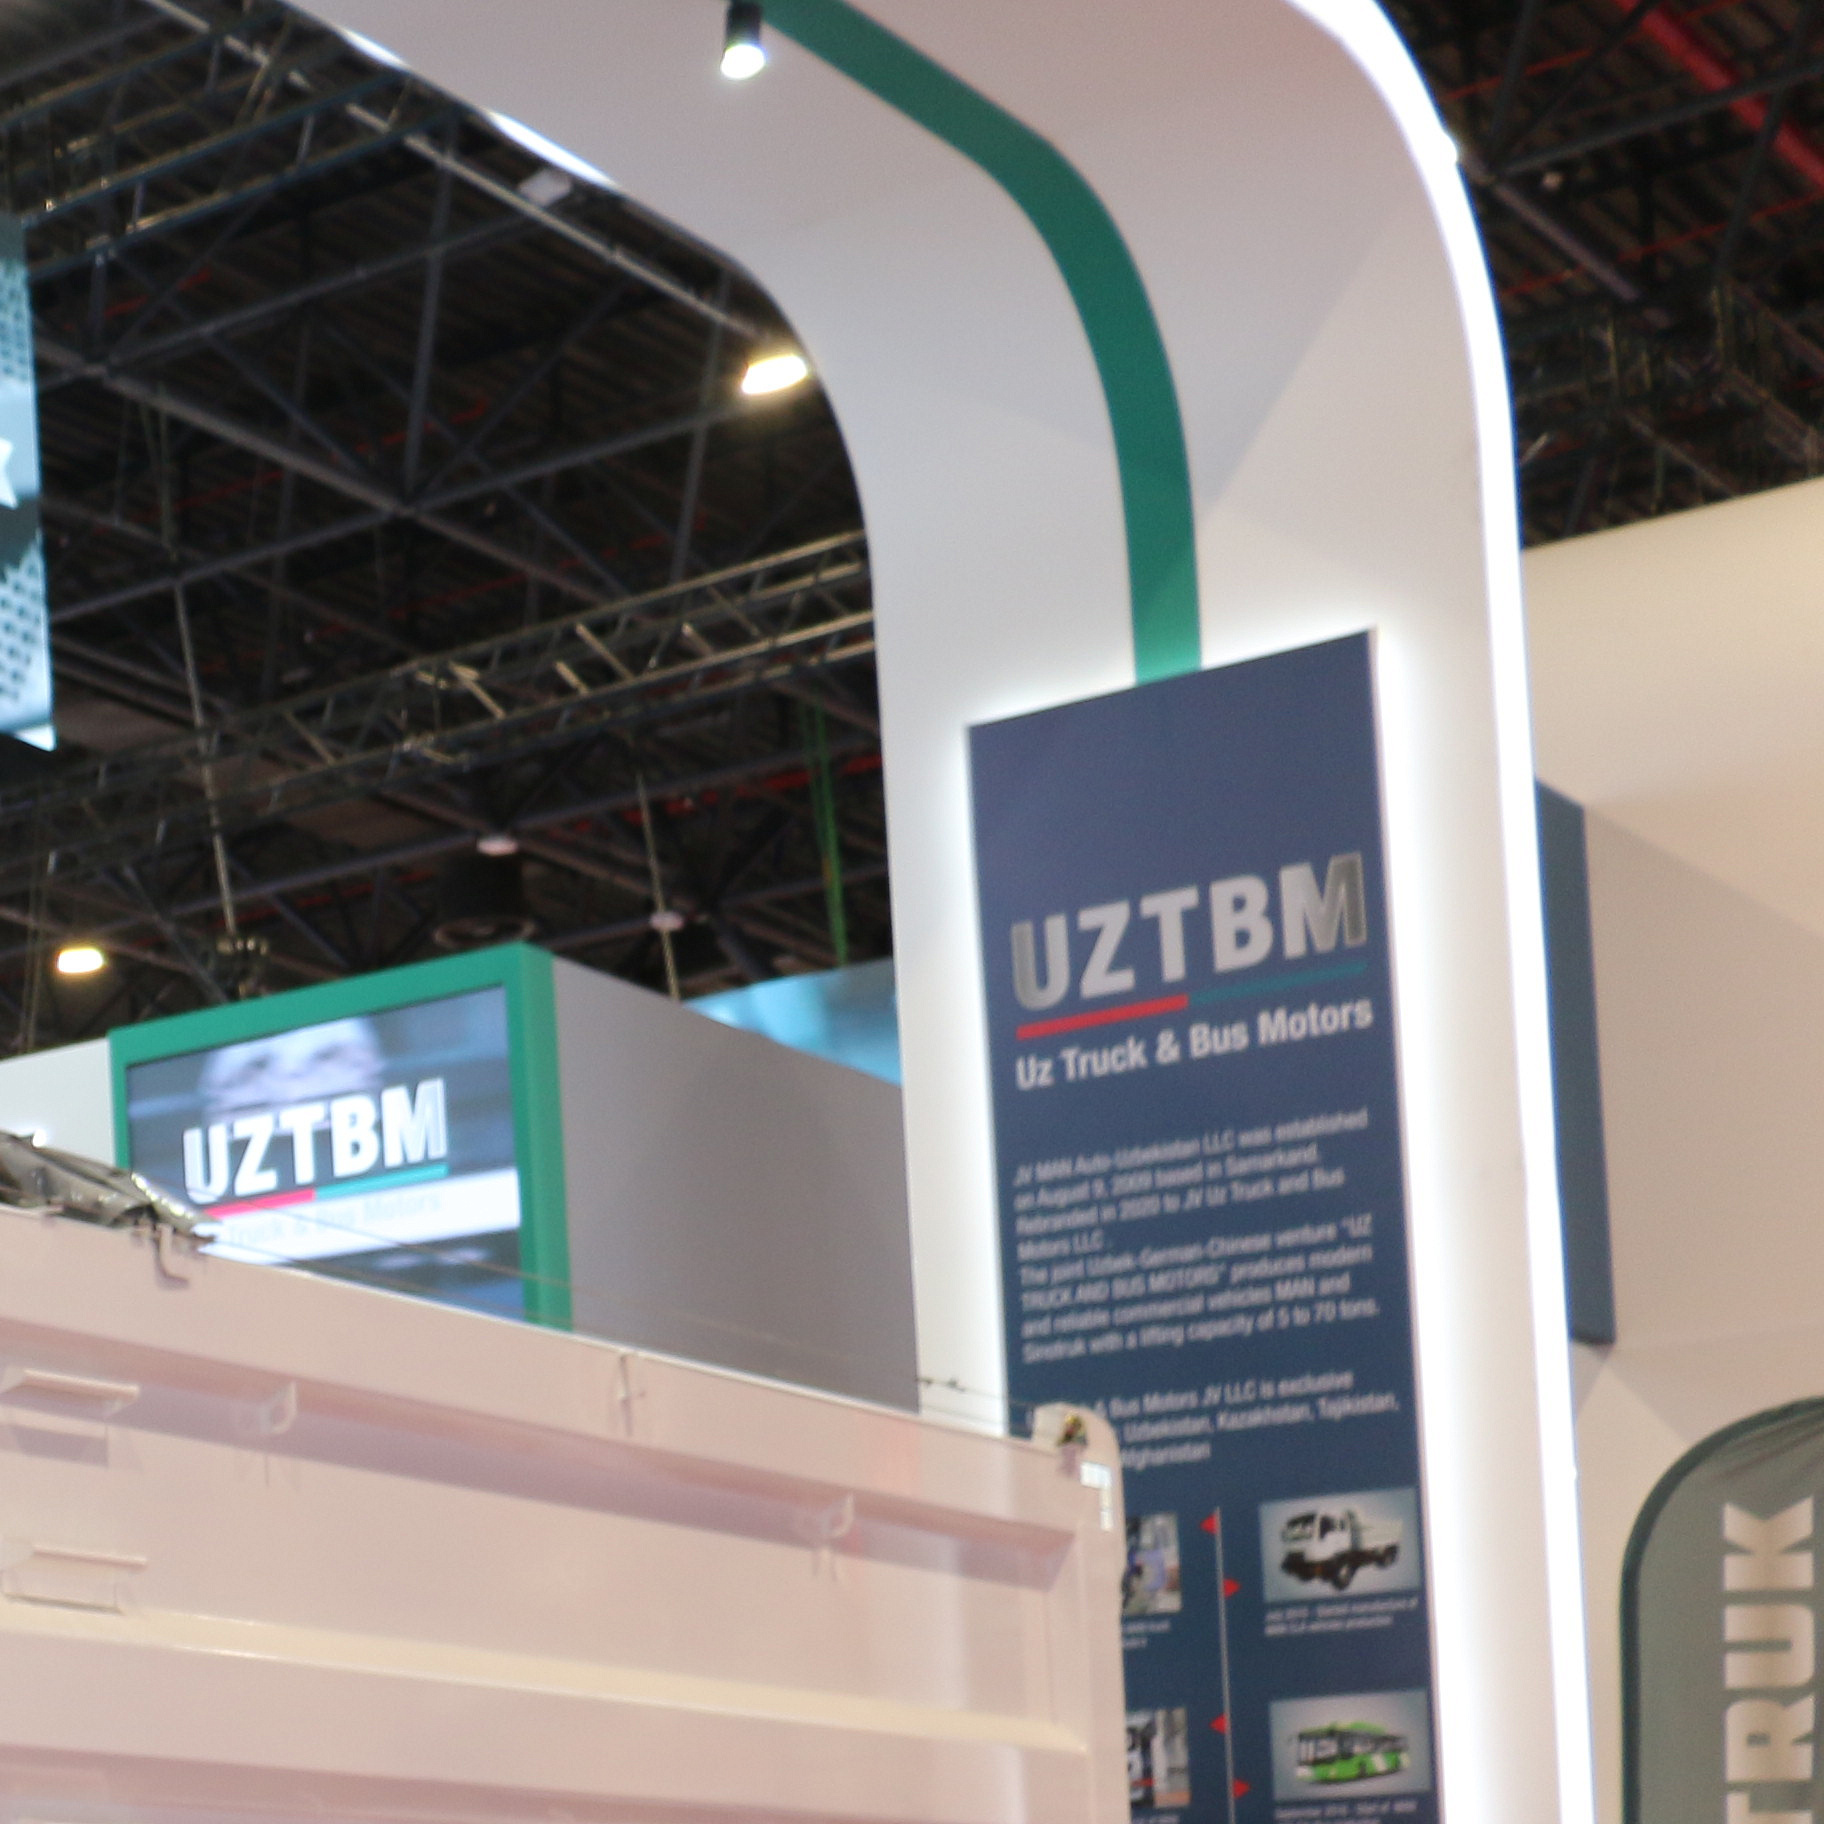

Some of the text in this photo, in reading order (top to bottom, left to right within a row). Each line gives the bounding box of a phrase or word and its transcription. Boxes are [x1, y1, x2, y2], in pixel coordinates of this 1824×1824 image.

[1011, 852, 1367, 1010] UZTBM
[1016, 996, 1373, 1091] Uz Truck & Bus Motors
[182, 1077, 449, 1205] UZTBM
